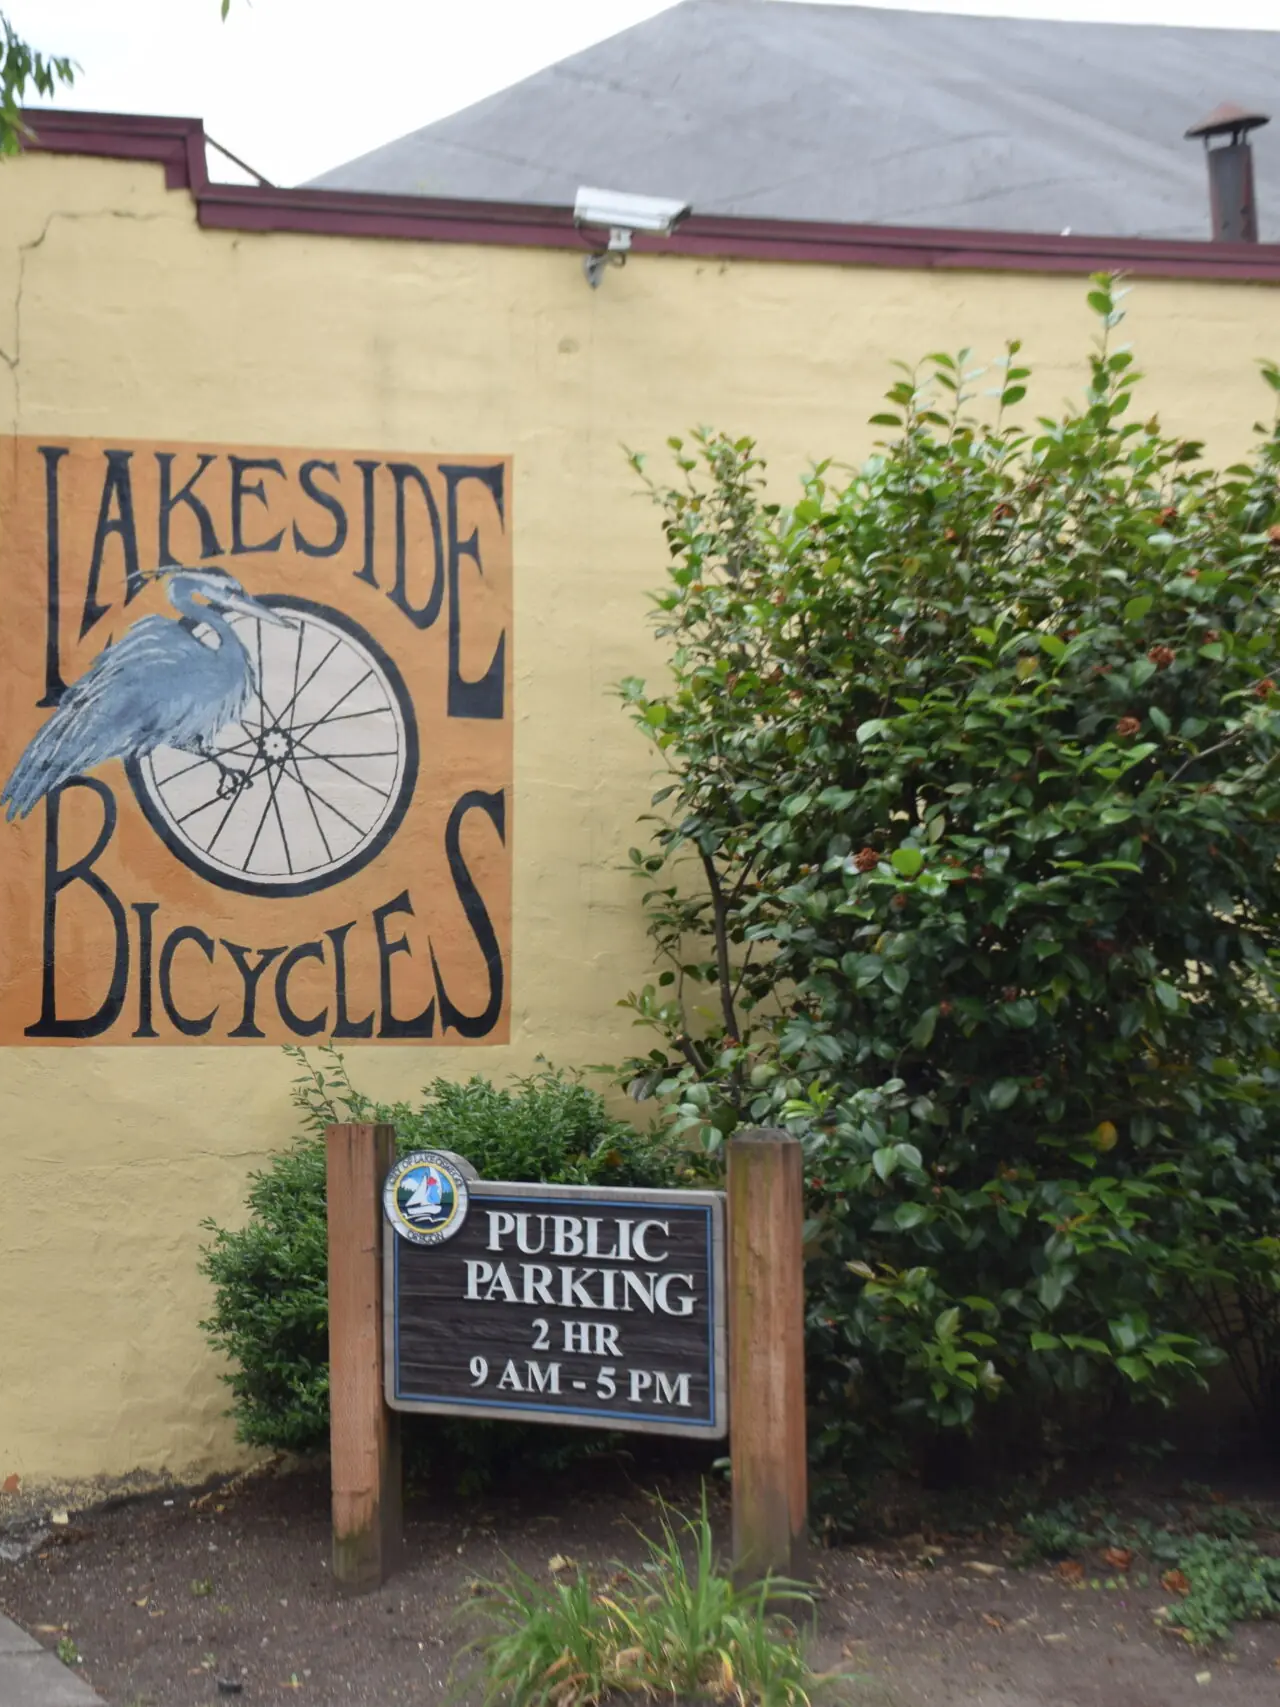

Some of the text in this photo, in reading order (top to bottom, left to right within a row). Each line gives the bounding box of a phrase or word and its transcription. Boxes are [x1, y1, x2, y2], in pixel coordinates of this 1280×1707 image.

[35, 446, 505, 719] LAKESIDE
[24, 776, 505, 1038] BICYCLES
[388, 1165, 402, 1183] CITY
[413, 1153, 435, 1164] LAKE
[407, 1230, 444, 1243] OREGON
[486, 1211, 669, 1262] PUBLIC
[463, 1260, 697, 1316] PARKING
[531, 1318, 623, 1357] 2 HR
[469, 1355, 488, 1388] 9
[496, 1359, 562, 1395] AM
[596, 1366, 616, 1400] 5
[628, 1369, 692, 1407] PM
